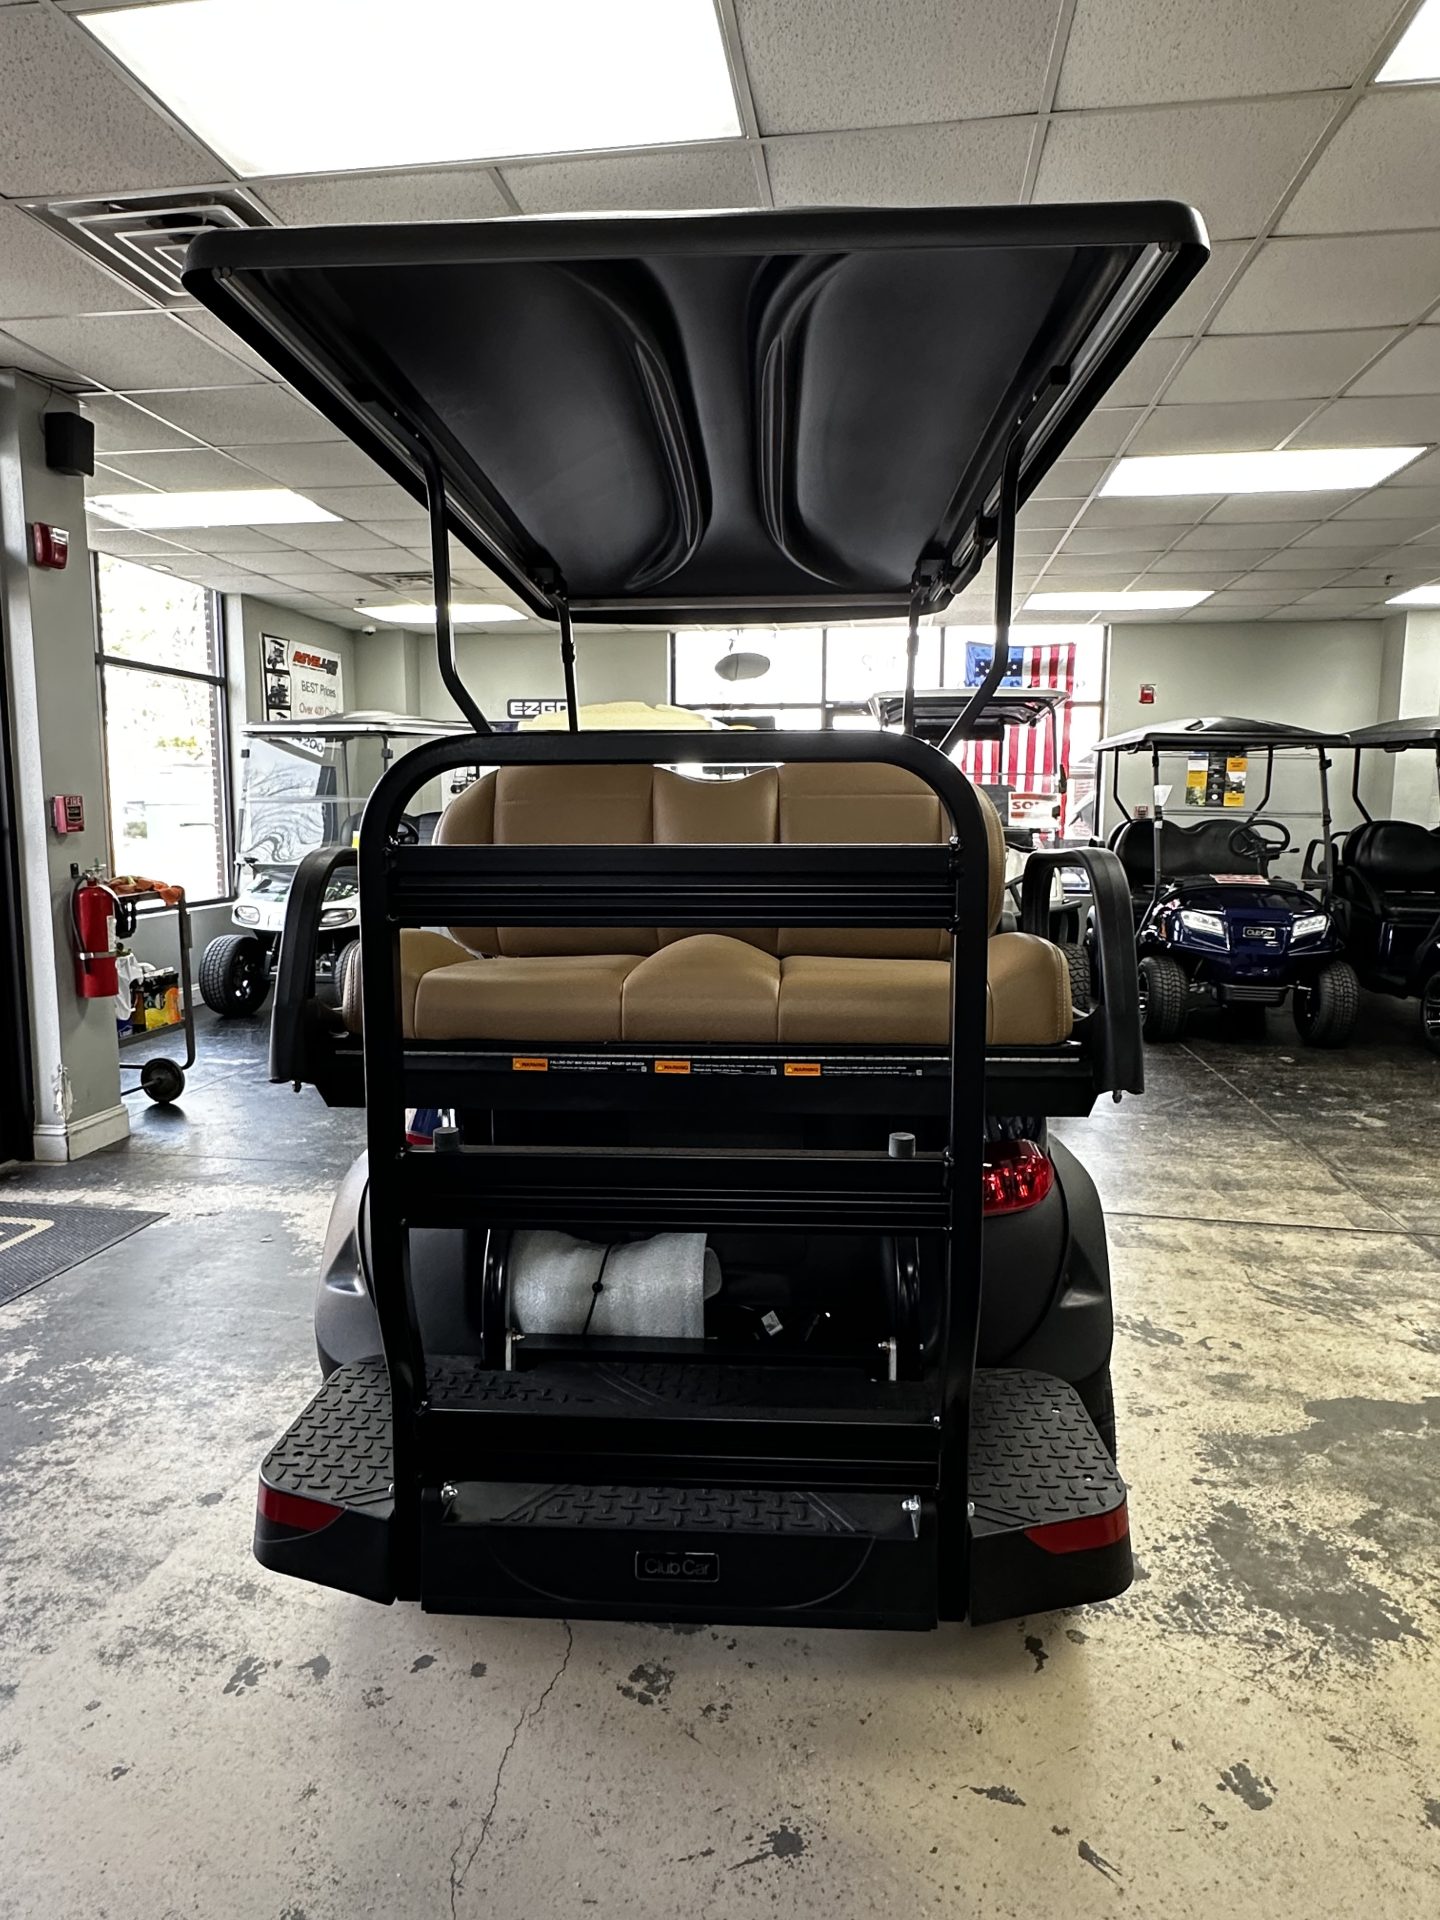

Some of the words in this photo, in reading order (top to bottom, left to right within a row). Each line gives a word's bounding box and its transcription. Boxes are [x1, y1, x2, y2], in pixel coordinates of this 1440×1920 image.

[301, 680, 319, 694] BEST
[645, 1558, 680, 1575] Club
[682, 1559, 710, 1575] Car
